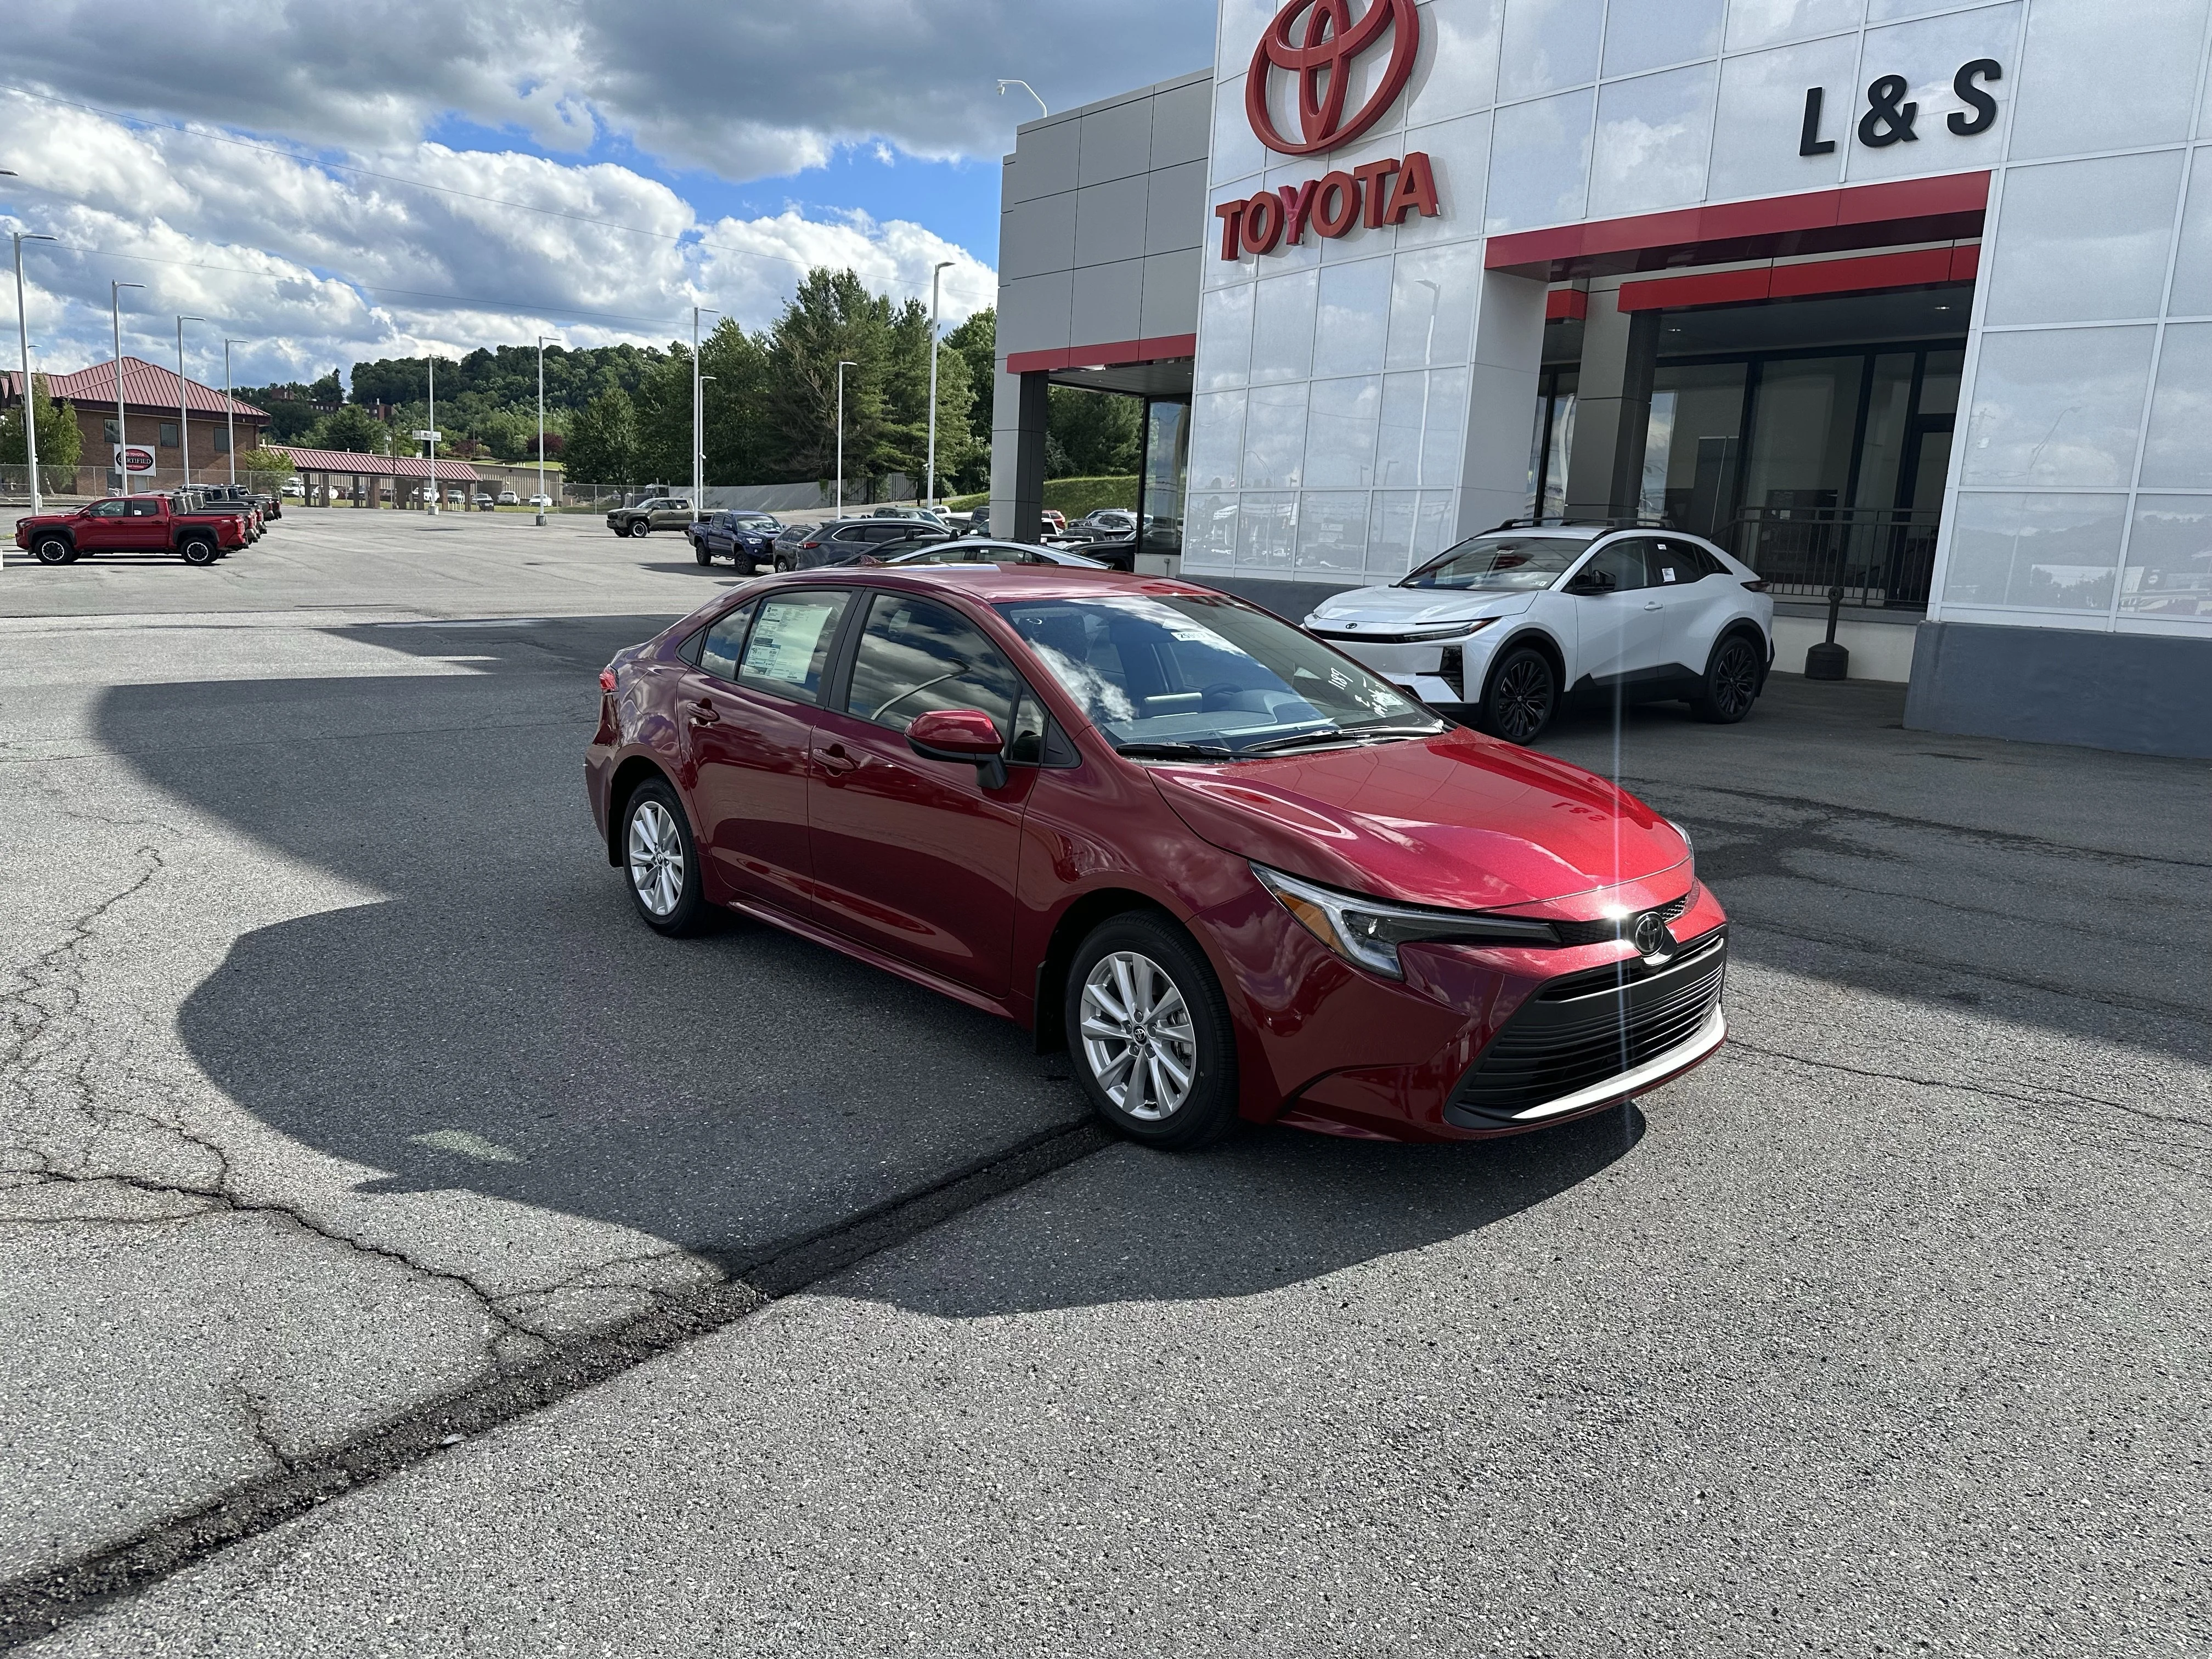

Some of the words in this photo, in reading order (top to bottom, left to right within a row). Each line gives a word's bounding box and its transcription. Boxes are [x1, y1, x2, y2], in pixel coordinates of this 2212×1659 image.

[1799, 87, 1835, 156] L
[1858, 74, 1919, 148] &
[1947, 58, 2002, 136] S
[1216, 151, 1441, 261] TOYOTA
